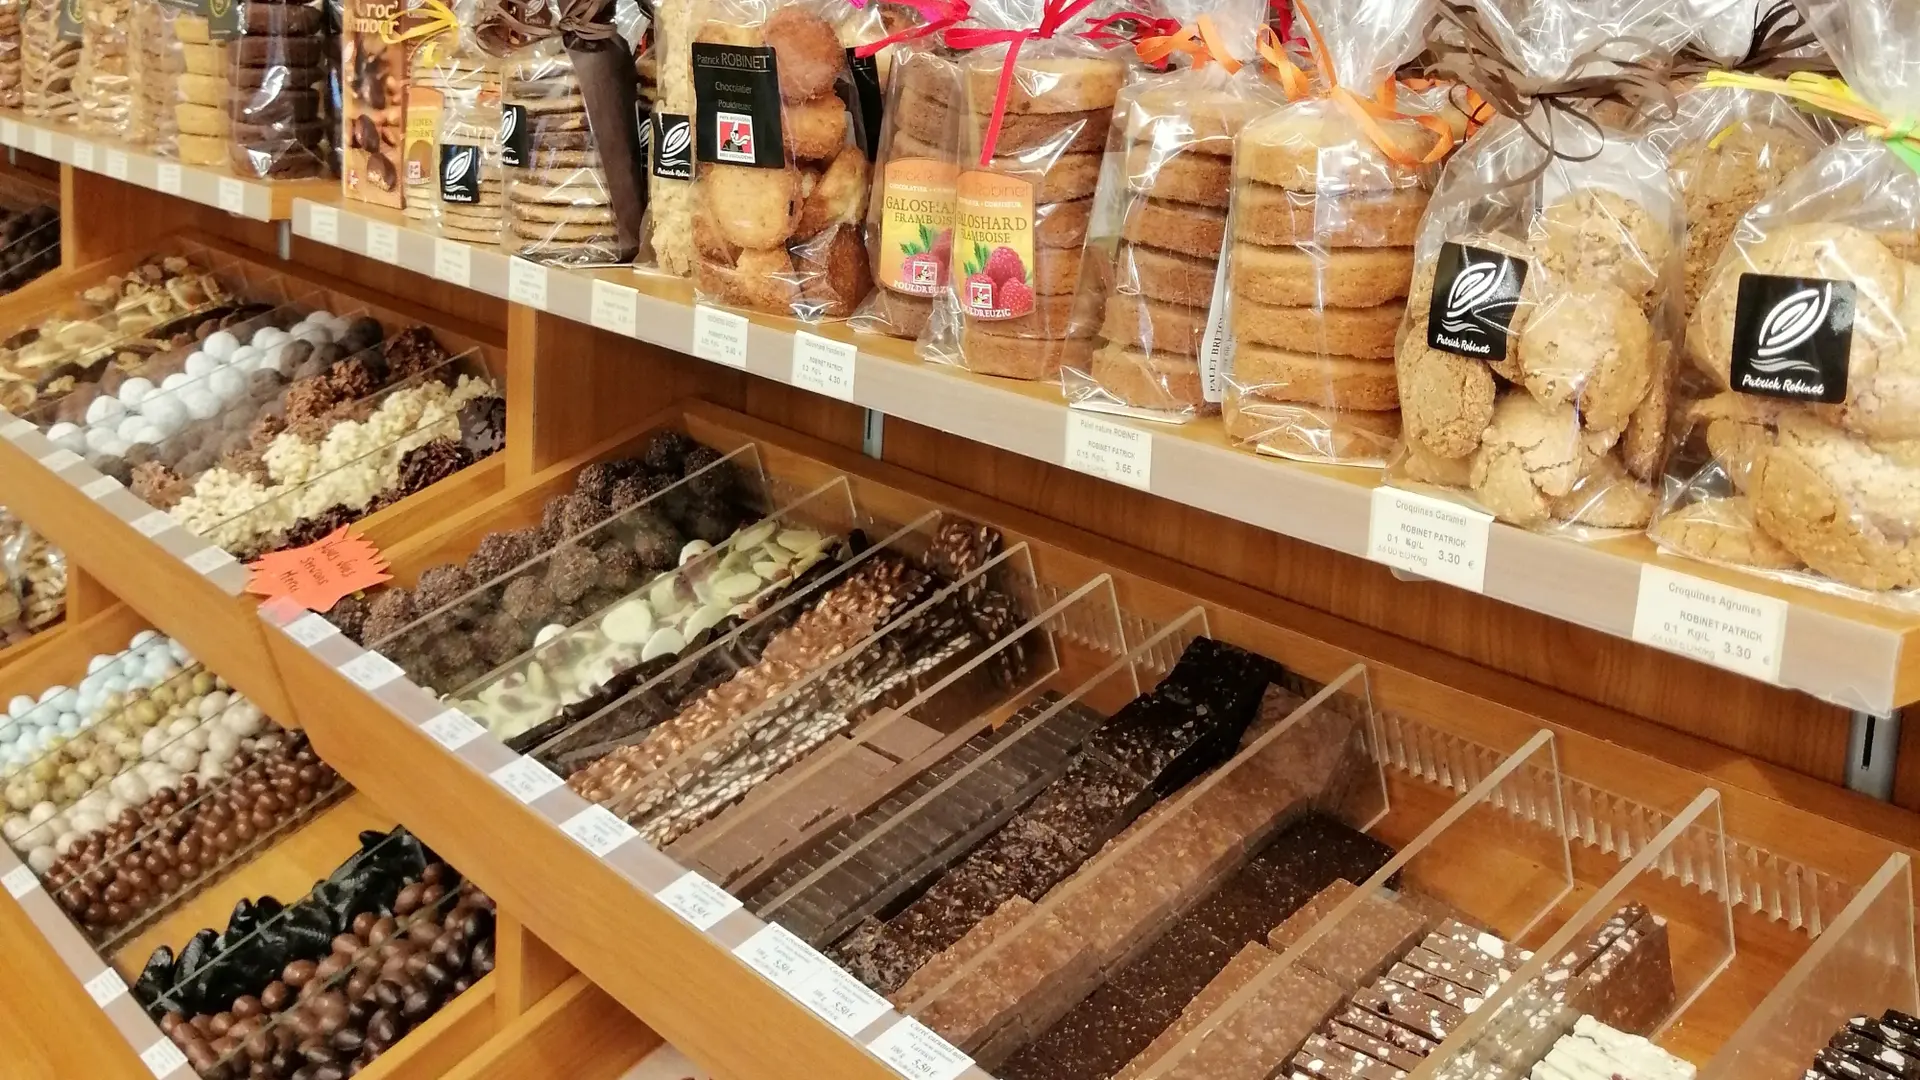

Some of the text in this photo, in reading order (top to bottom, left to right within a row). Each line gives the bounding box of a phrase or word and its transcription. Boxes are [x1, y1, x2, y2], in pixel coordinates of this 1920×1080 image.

[697, 52, 769, 69] Patrick ROBINET
[715, 81, 752, 94] Chocolatier
[1436, 333, 1490, 354] Patrick Robinet
[1742, 374, 1825, 396] Patrick Robinet
[1395, 499, 1467, 526] Croquines Caramel
[1400, 523, 1467, 549] ROBINET PATRICK
[1438, 549, 1461, 565] 3.30
[1668, 581, 1762, 617] Croquines Agrumes
[1680, 610, 1763, 643] ROBINET PATRICK
[1687, 627, 1710, 642] Kg/L
[1723, 642, 1751, 660] 3.30
